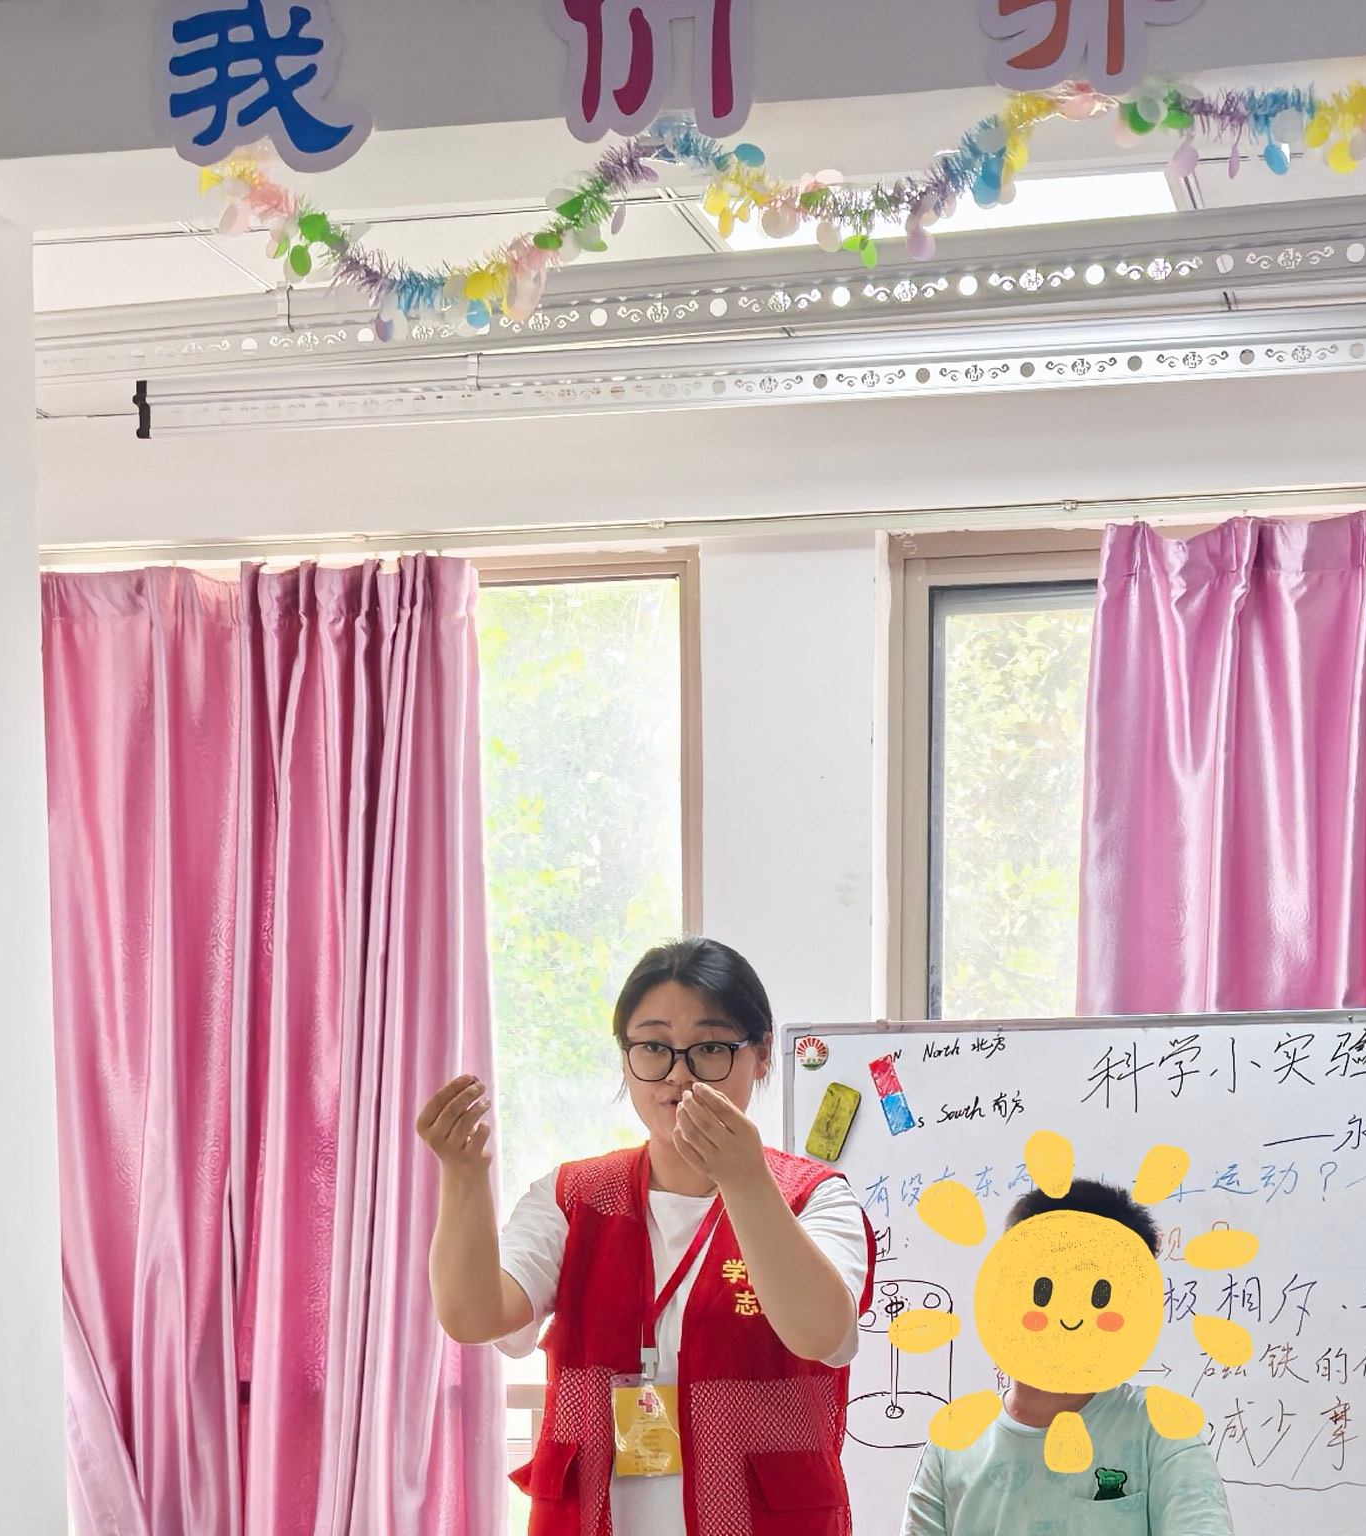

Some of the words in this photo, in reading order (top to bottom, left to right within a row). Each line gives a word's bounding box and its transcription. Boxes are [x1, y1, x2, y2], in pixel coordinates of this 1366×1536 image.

[922, 1038, 960, 1062] North
[970, 1034, 1006, 1059] 北方
[937, 1096, 986, 1124] South
[992, 1090, 1025, 1125] 南方
[722, 1259, 752, 1286] 学
[735, 1290, 764, 1316] 志
